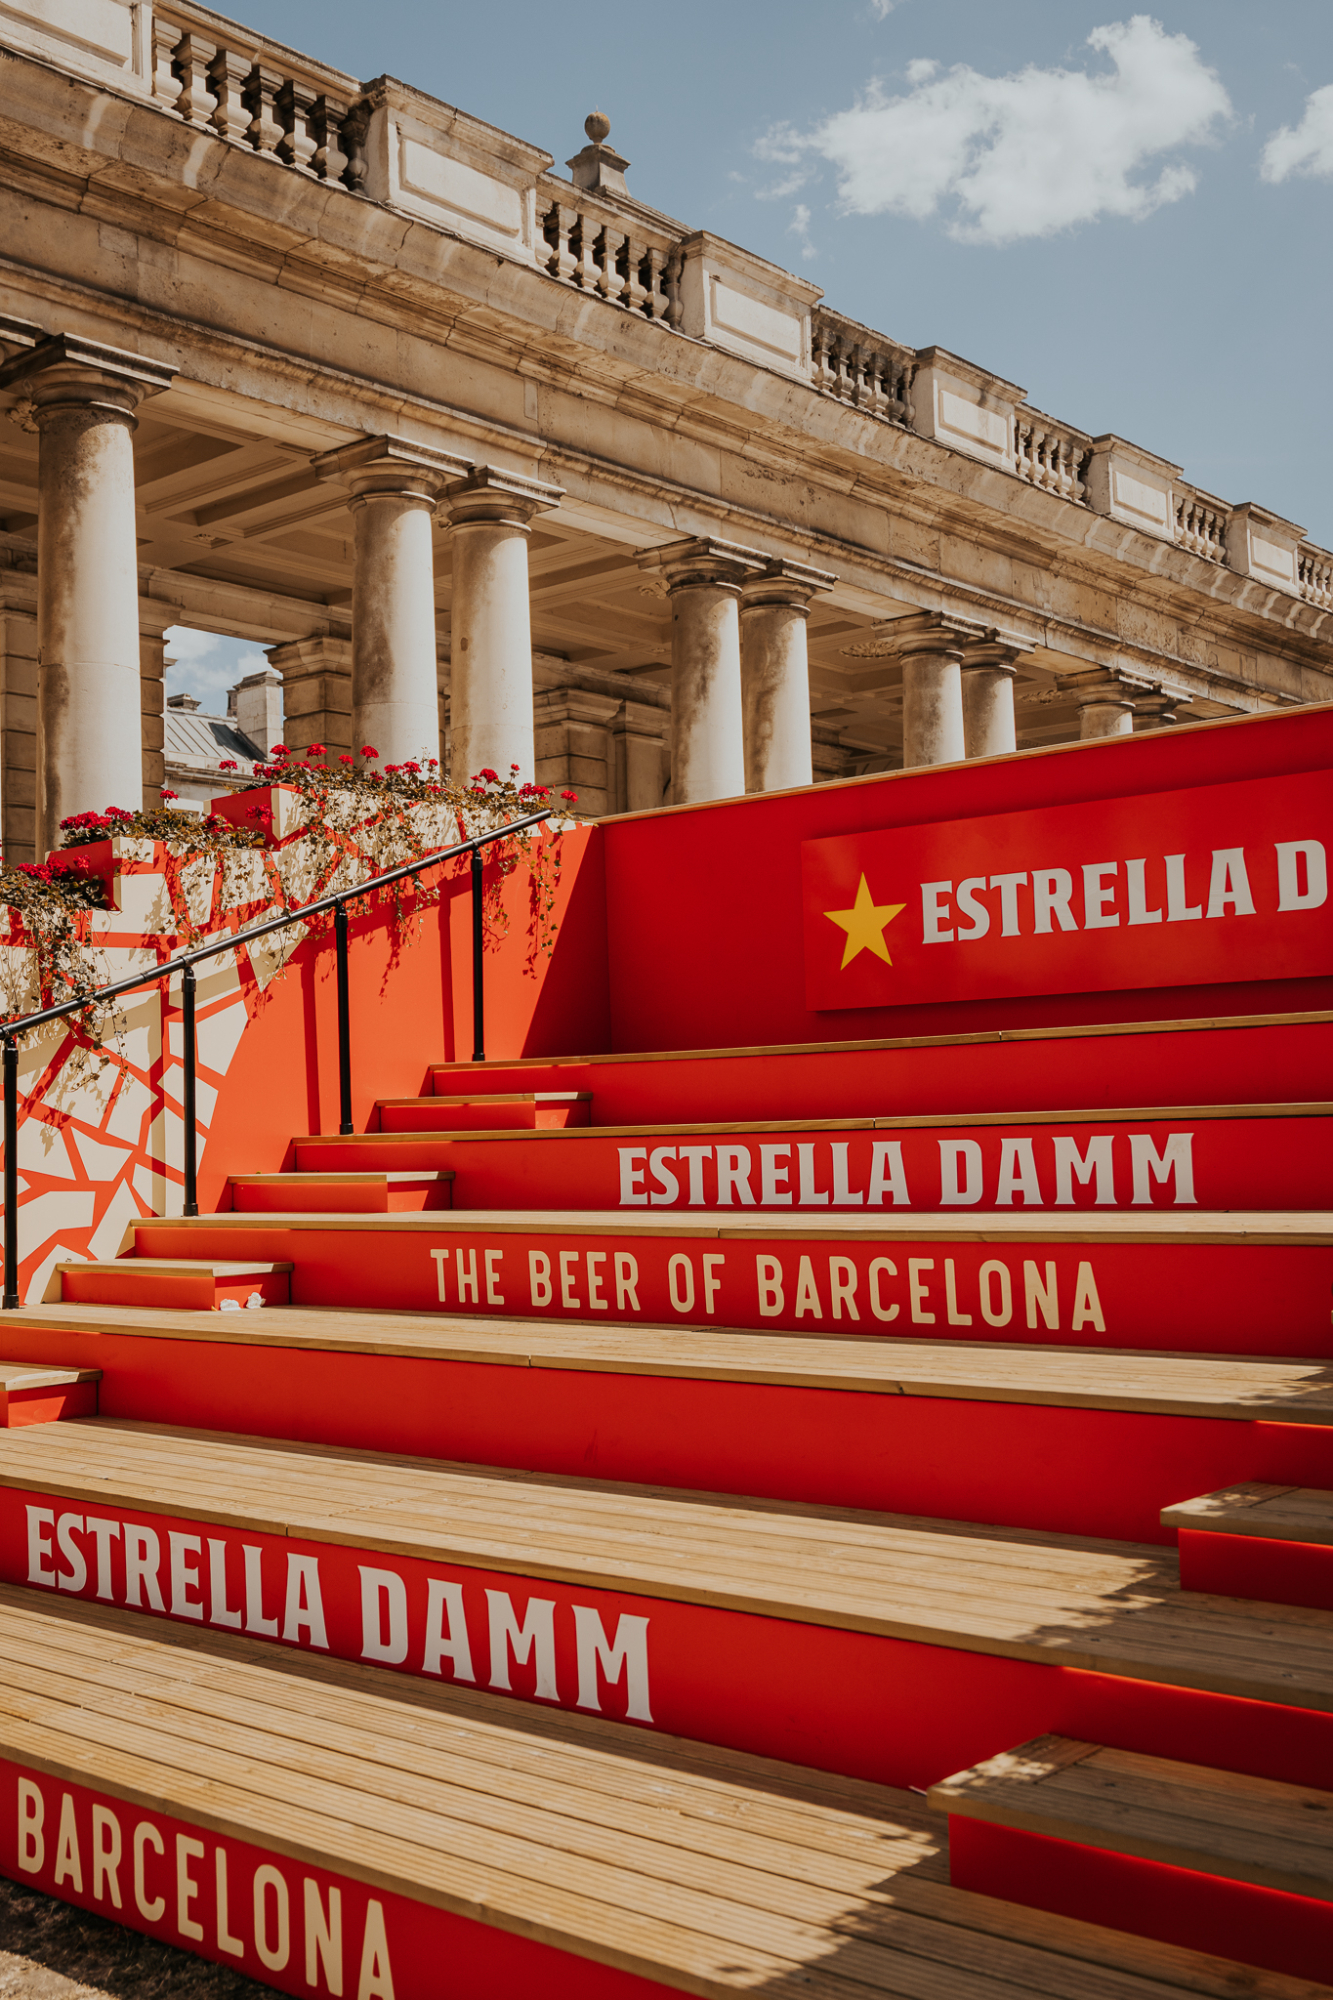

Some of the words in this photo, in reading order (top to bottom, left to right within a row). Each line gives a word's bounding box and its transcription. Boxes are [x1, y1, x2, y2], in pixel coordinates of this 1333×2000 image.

[920, 847, 1257, 944] ESTRELLA
[617, 1140, 911, 1205] ESTRELLA
[938, 1133, 1198, 1205] DAMM
[430, 1248, 504, 1304] THE
[528, 1250, 641, 1311] BEER
[668, 1253, 725, 1314] OF
[756, 1254, 1106, 1332] BARCELONA
[25, 1504, 330, 1649] ESTRELLA
[357, 1565, 654, 1723] DAMM
[17, 1776, 395, 2000] BARCELONA
